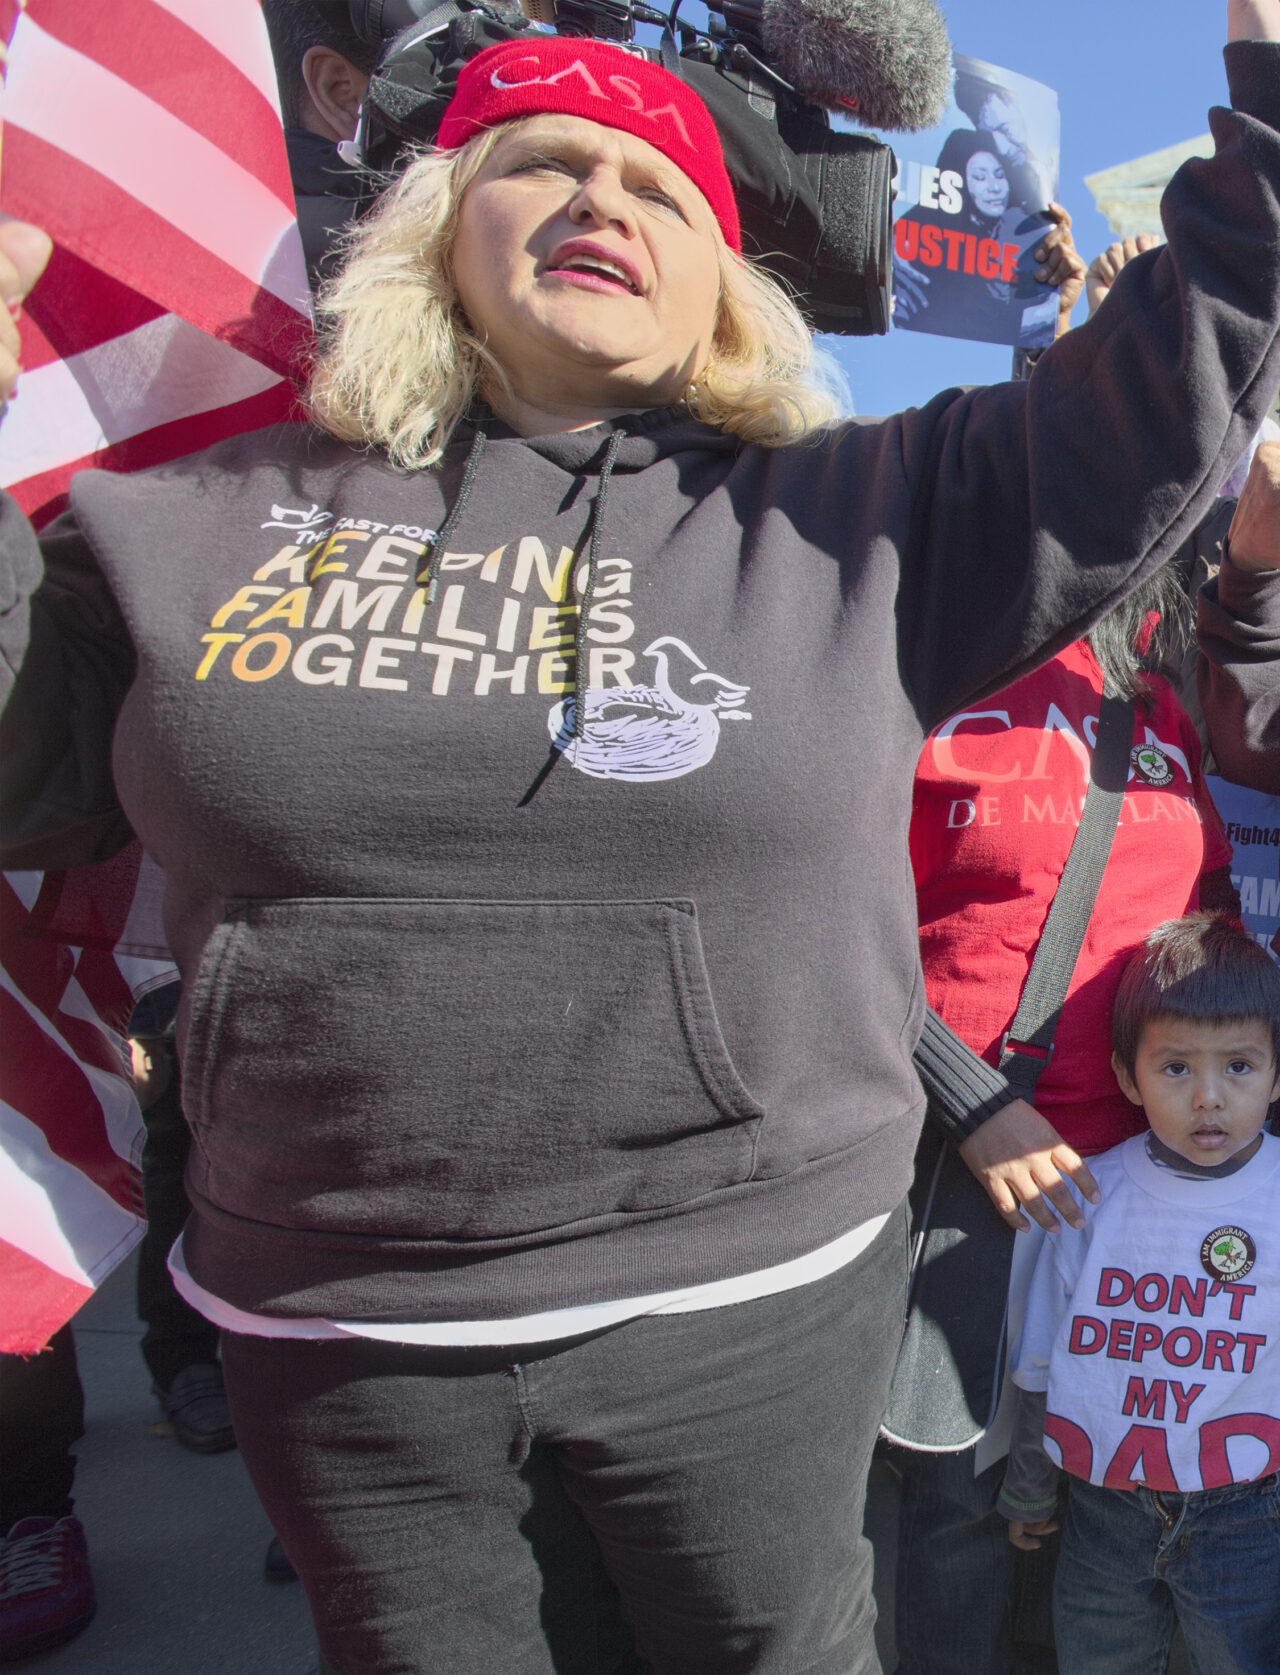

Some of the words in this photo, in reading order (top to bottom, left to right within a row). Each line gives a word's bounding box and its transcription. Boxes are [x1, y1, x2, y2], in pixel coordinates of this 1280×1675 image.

[490, 56, 698, 152] CASA
[891, 158, 963, 214] LIES
[894, 218, 1020, 283] USTICE
[296, 530, 331, 545] THE
[332, 517, 389, 533] FAST
[389, 523, 439, 545] FOR
[210, 579, 636, 652] FAMILIES
[195, 632, 636, 696] TOGETHER
[1148, 773, 1174, 786] AMERICA
[946, 797, 1001, 828] DE
[1020, 794, 1203, 828] MALAN
[1225, 822, 1280, 847] Fight4
[1202, 1243, 1210, 1256] AM
[1207, 1227, 1248, 1243] IMMIGRANT
[1096, 1267, 1257, 1321] DON'T
[1220, 1260, 1254, 1281] AMERICA
[1068, 1315, 1268, 1374] DEPORT
[1121, 1376, 1207, 1424] MY
